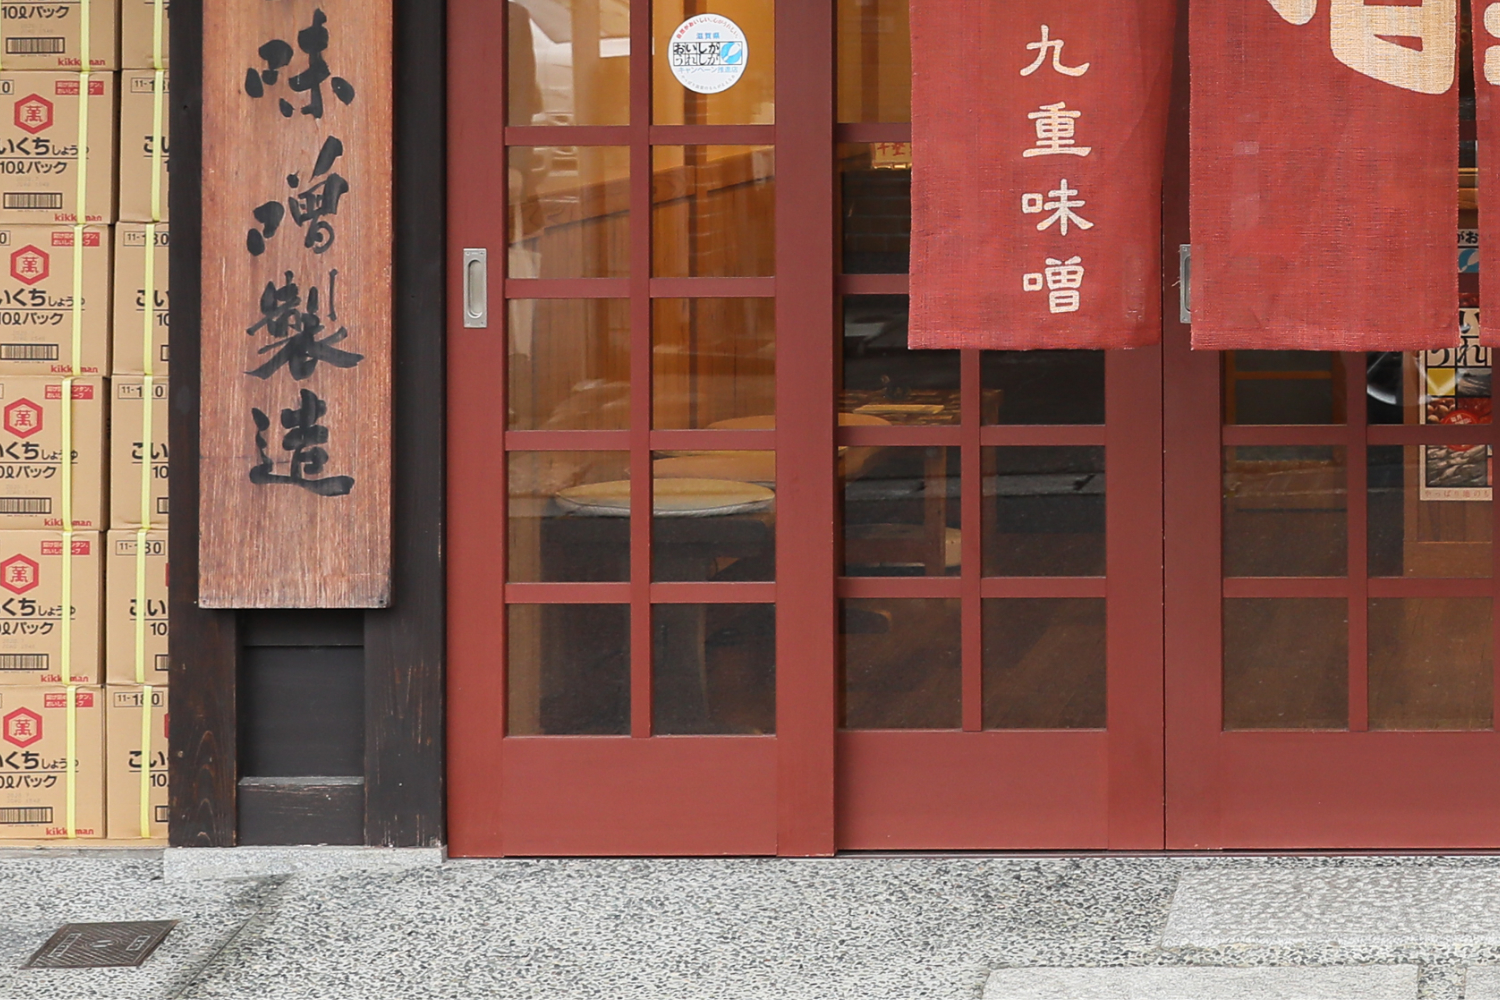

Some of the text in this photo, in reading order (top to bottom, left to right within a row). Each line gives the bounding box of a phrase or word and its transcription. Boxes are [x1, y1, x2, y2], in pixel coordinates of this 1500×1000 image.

[673, 42, 720, 56] おいしが
[58, 58, 106, 66] kikkman
[1019, 24, 1094, 314] 九重味噌
[54, 213, 102, 221] kikkman
[51, 365, 98, 373] kikkman
[121, 386, 163, 397] 11-10
[120, 542, 161, 554] 11-80
